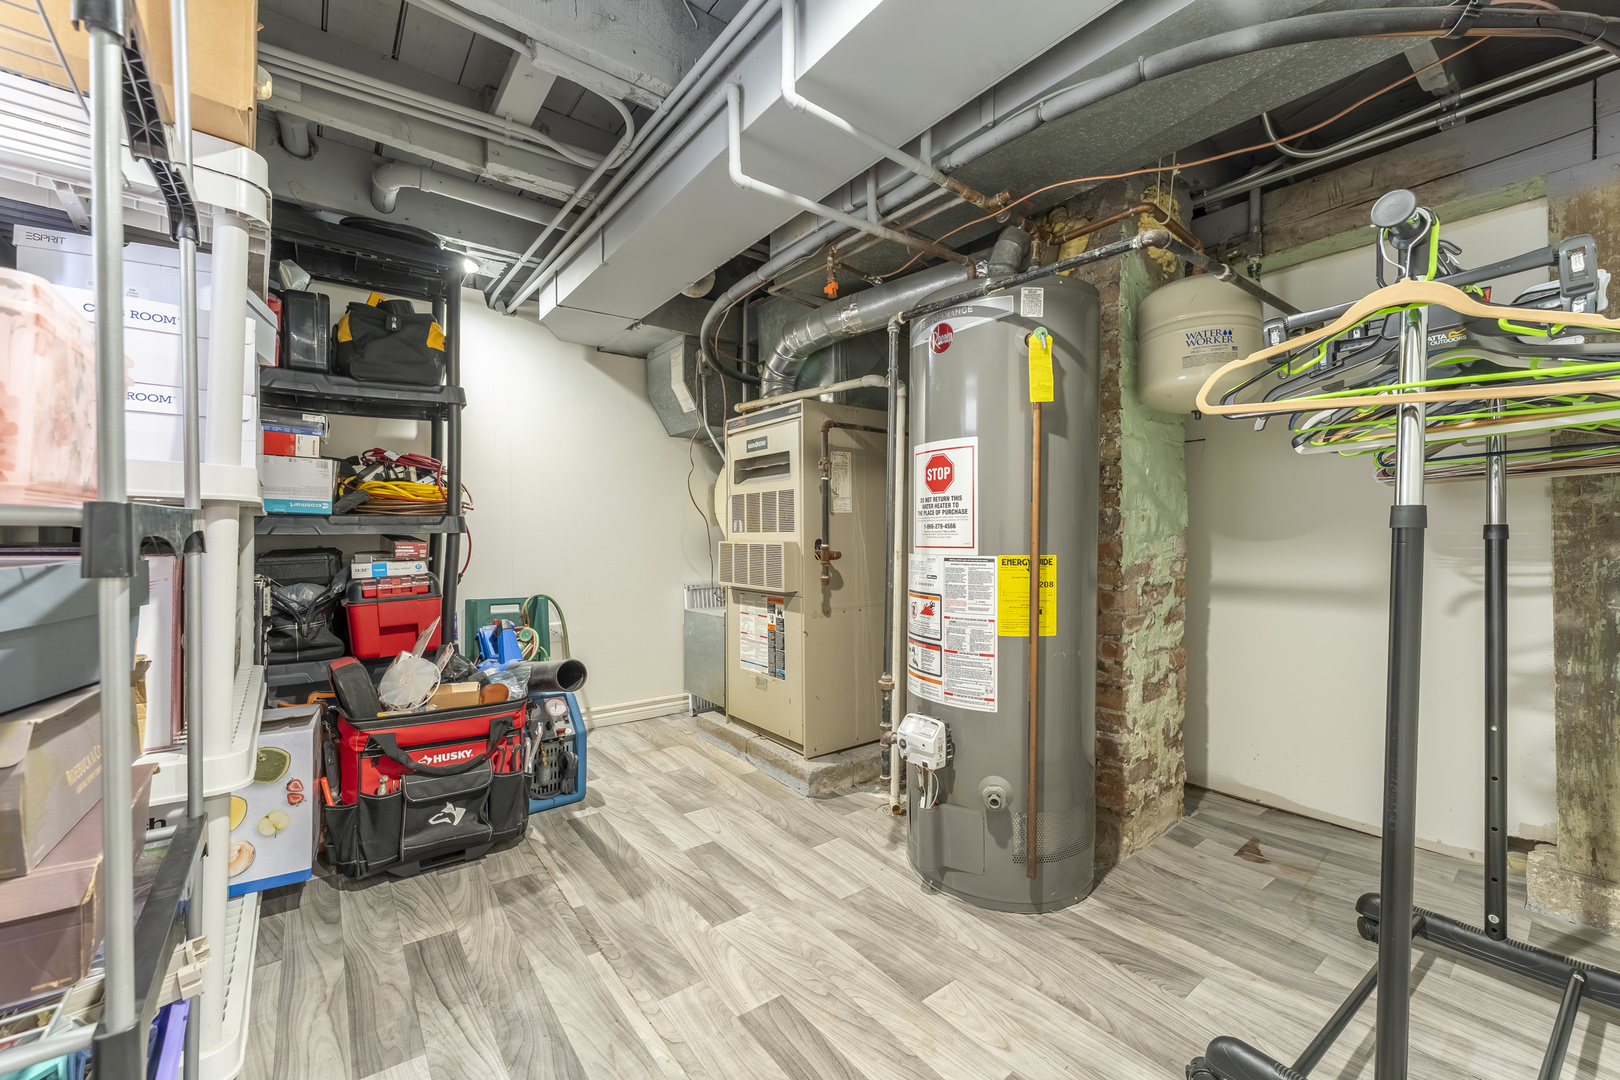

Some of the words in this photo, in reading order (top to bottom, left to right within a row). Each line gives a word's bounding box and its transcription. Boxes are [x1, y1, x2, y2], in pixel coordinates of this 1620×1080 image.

[25, 231, 66, 245] ESPRIT
[129, 309, 177, 325] ROOM
[932, 324, 953, 351] Rheem
[1185, 328, 1223, 340] WATER
[1427, 333, 1447, 342] ATTA
[1430, 334, 1467, 346] OUTDOORS
[1185, 335, 1234, 347] WORKER
[127, 391, 172, 404] ROOM
[926, 466, 951, 482] STOP
